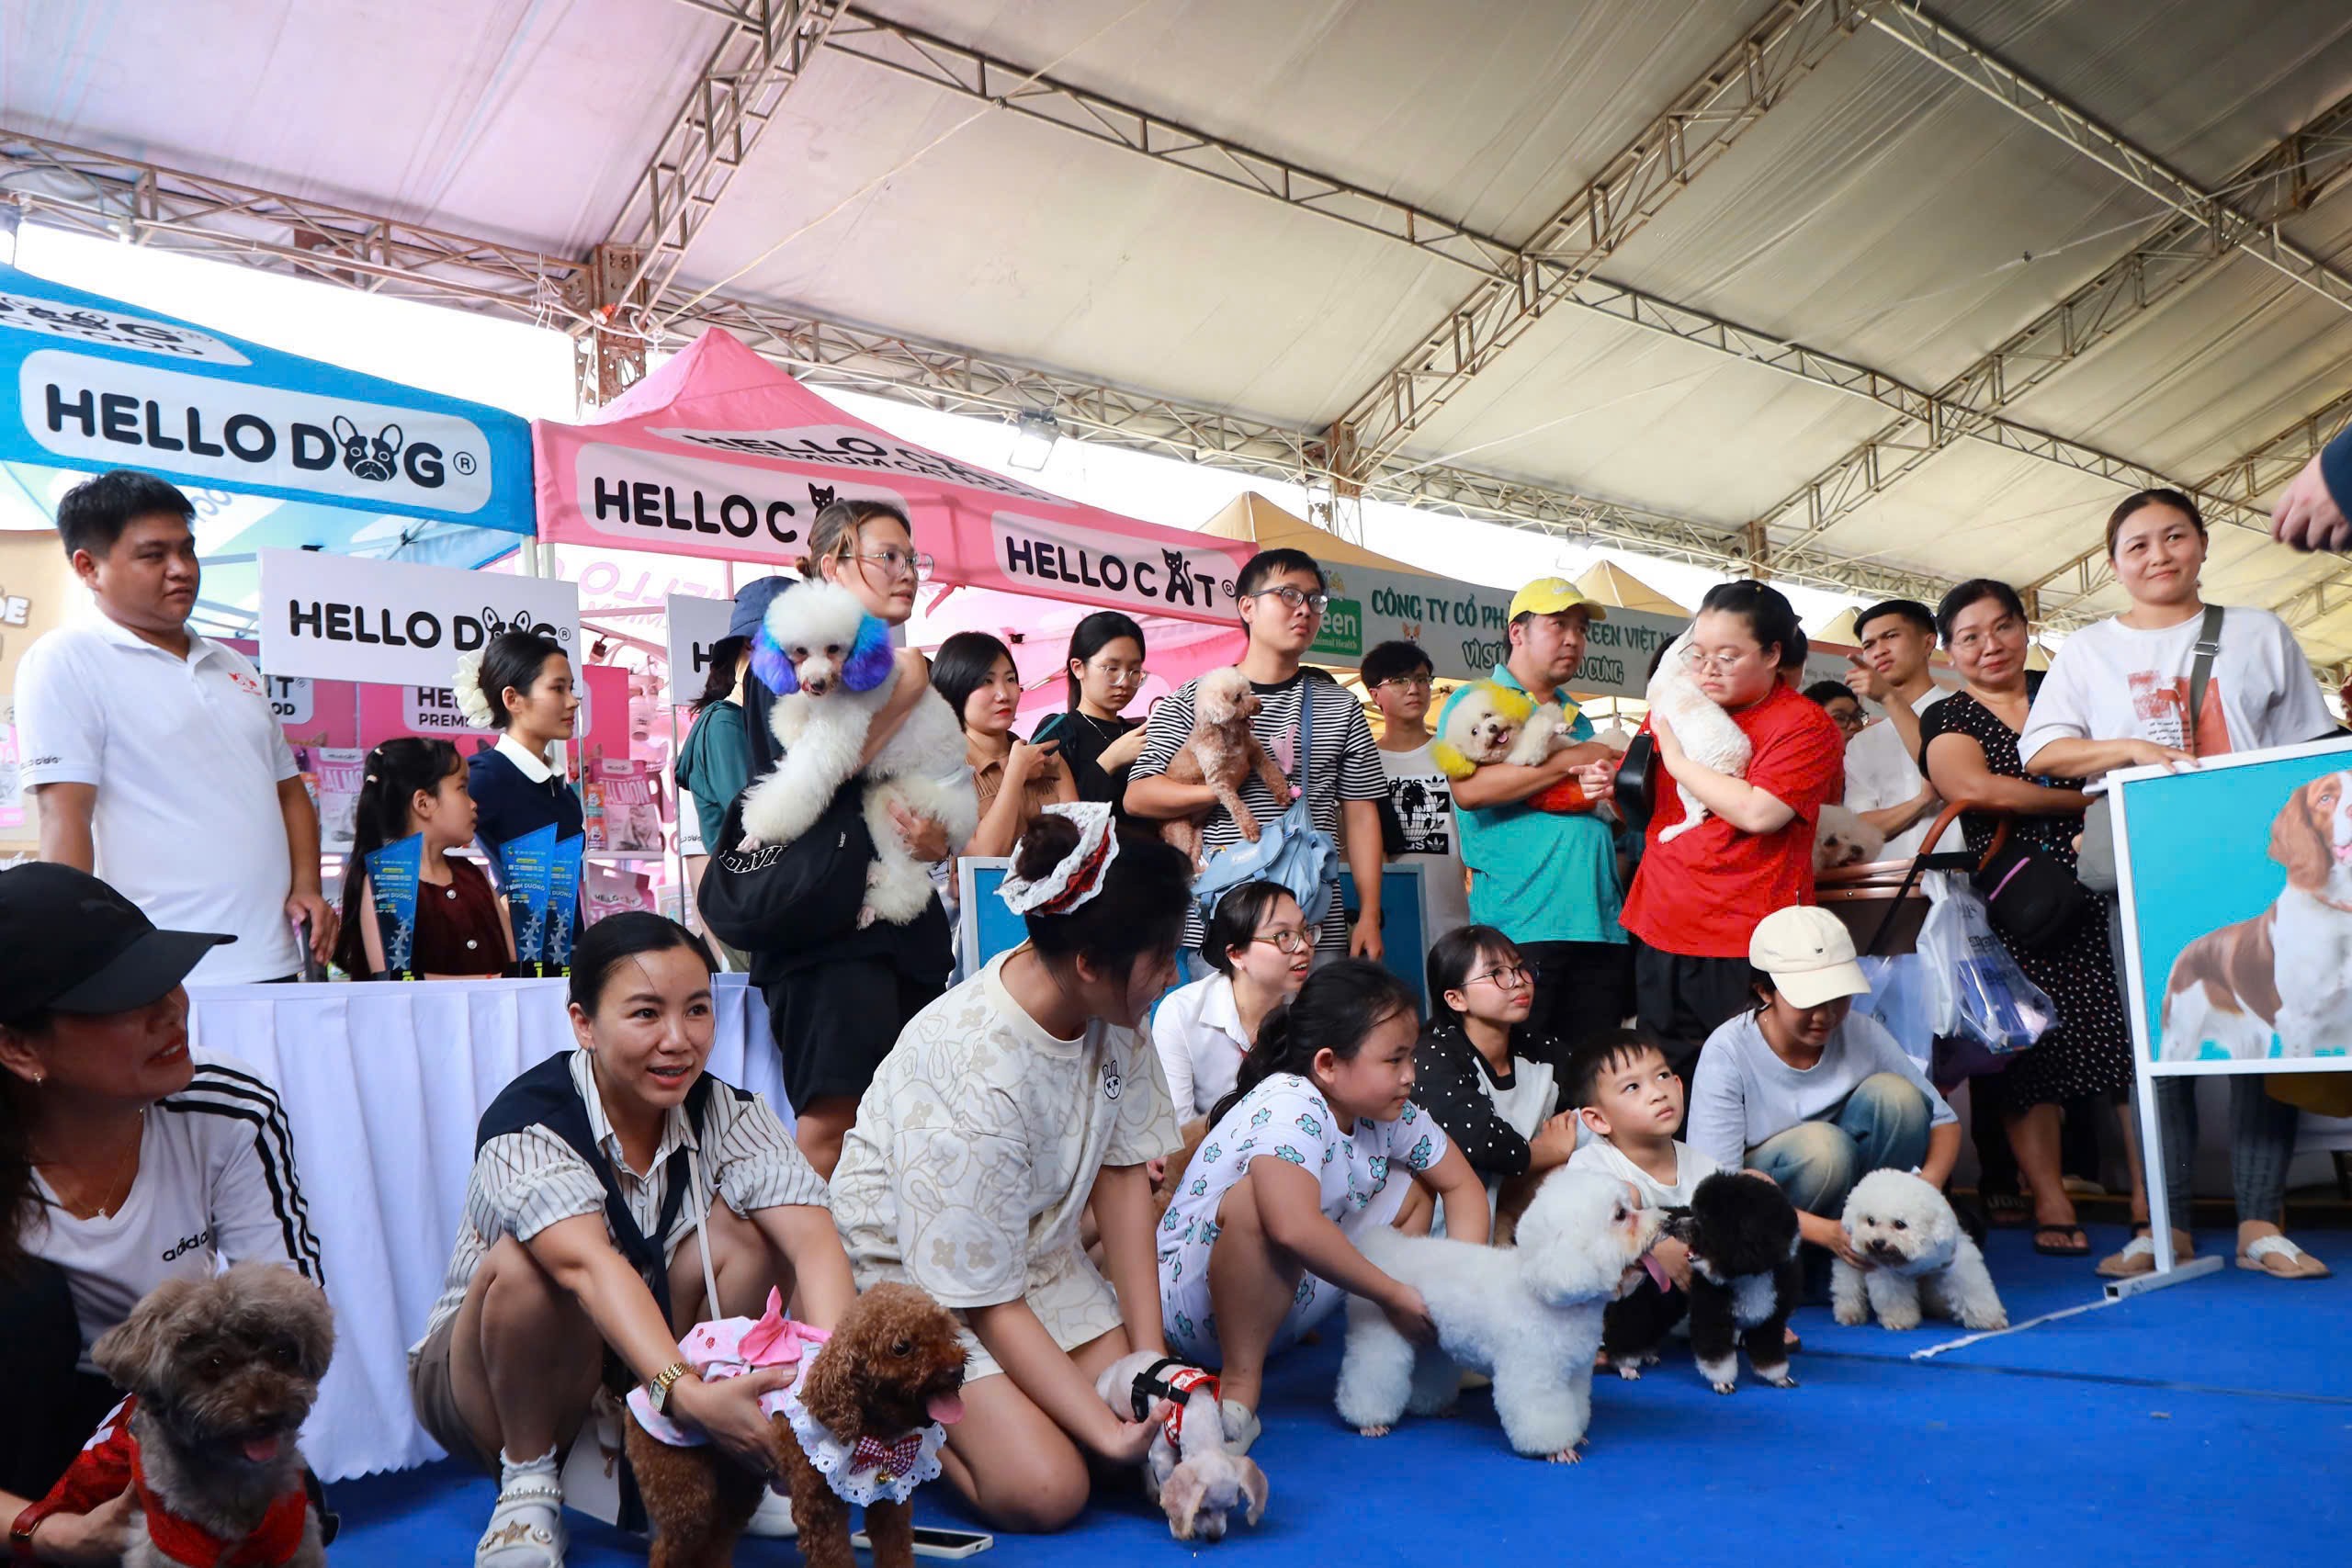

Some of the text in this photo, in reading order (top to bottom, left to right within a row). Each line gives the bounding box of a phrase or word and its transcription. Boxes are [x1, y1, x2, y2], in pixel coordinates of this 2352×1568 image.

[46, 384, 277, 463] HELLO
[682, 434, 888, 457] HELLO
[594, 477, 758, 538] HELLO
[1005, 536, 1128, 592] HELLO
[289, 599, 442, 649] HELLO
[1319, 611, 1357, 637] een
[1371, 586, 1423, 622] CÔNG
[1426, 598, 1449, 624] TY
